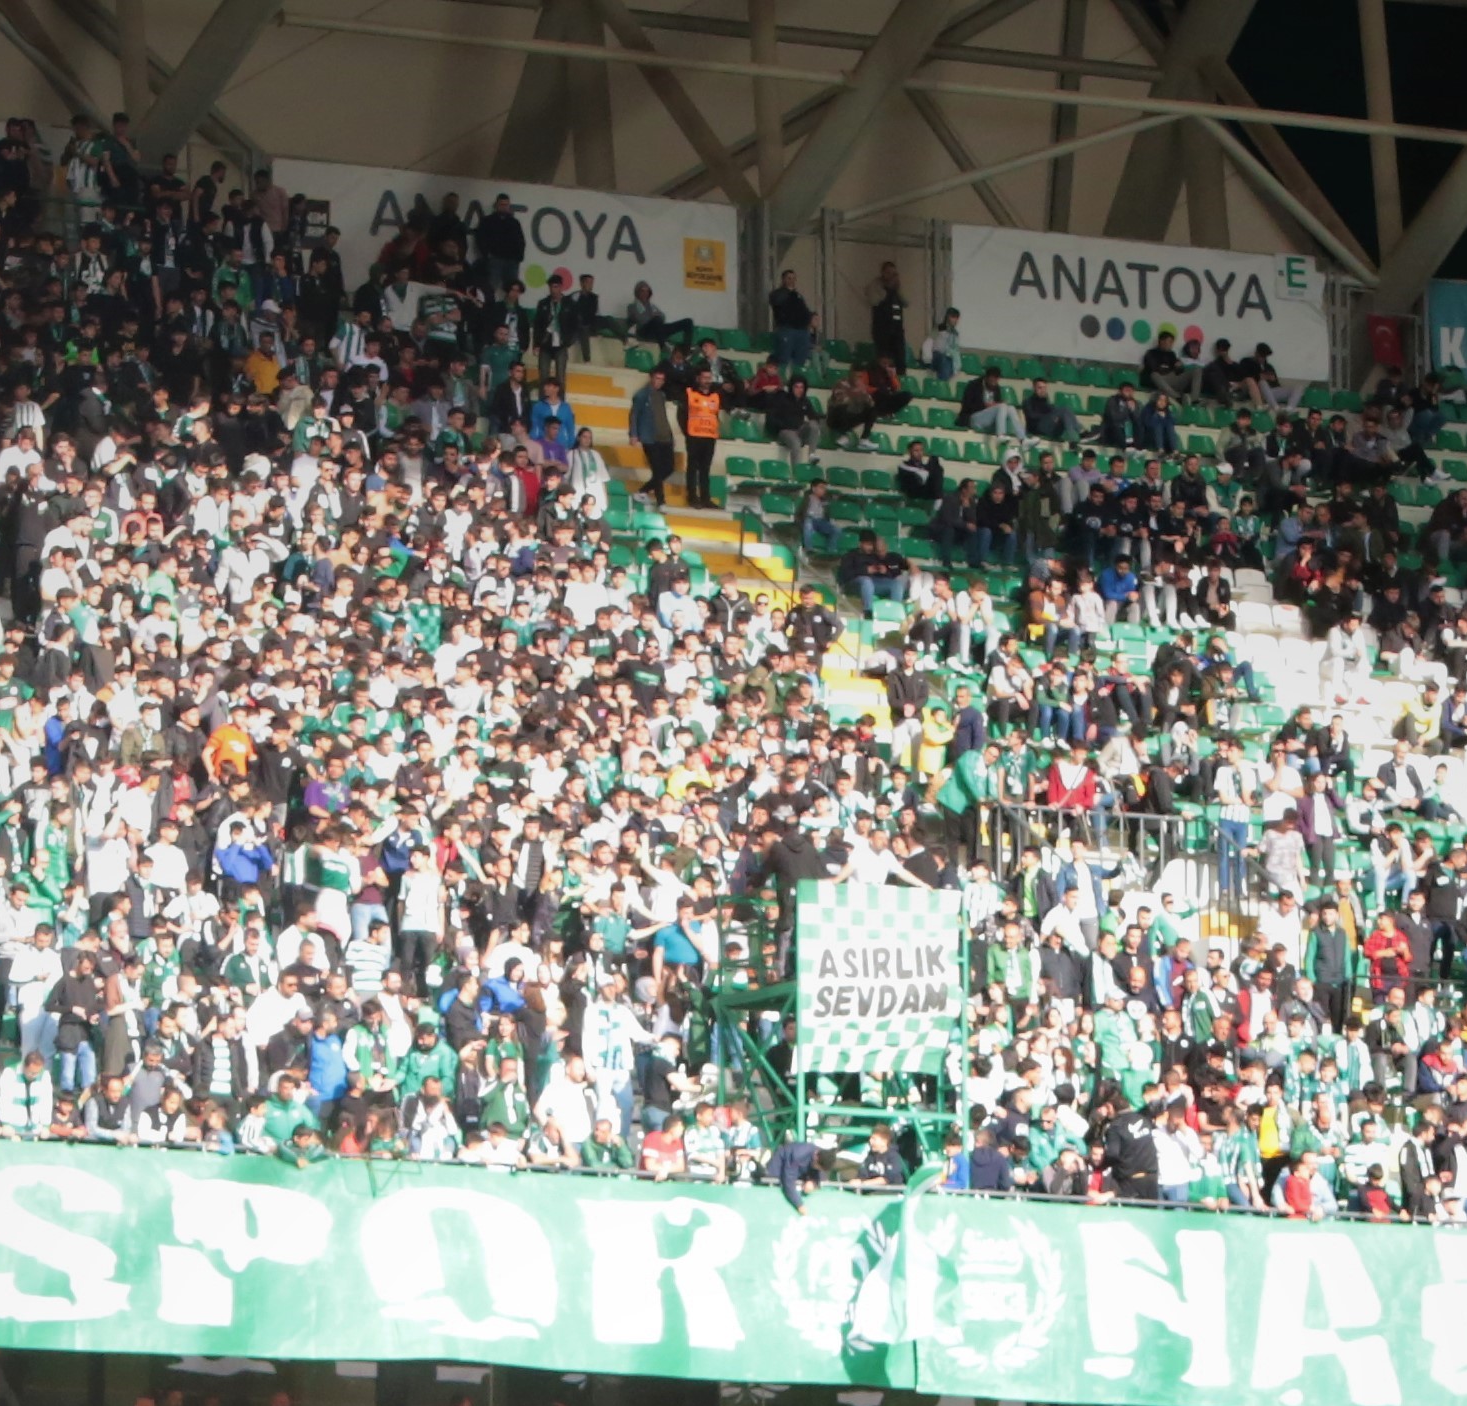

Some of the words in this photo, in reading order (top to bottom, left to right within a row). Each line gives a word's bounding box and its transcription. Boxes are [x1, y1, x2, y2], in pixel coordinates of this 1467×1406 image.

[1009, 251, 1273, 322] ANATOYA
[818, 944, 946, 980] ASIRLIK
[813, 982, 949, 1019] SEVDAM
